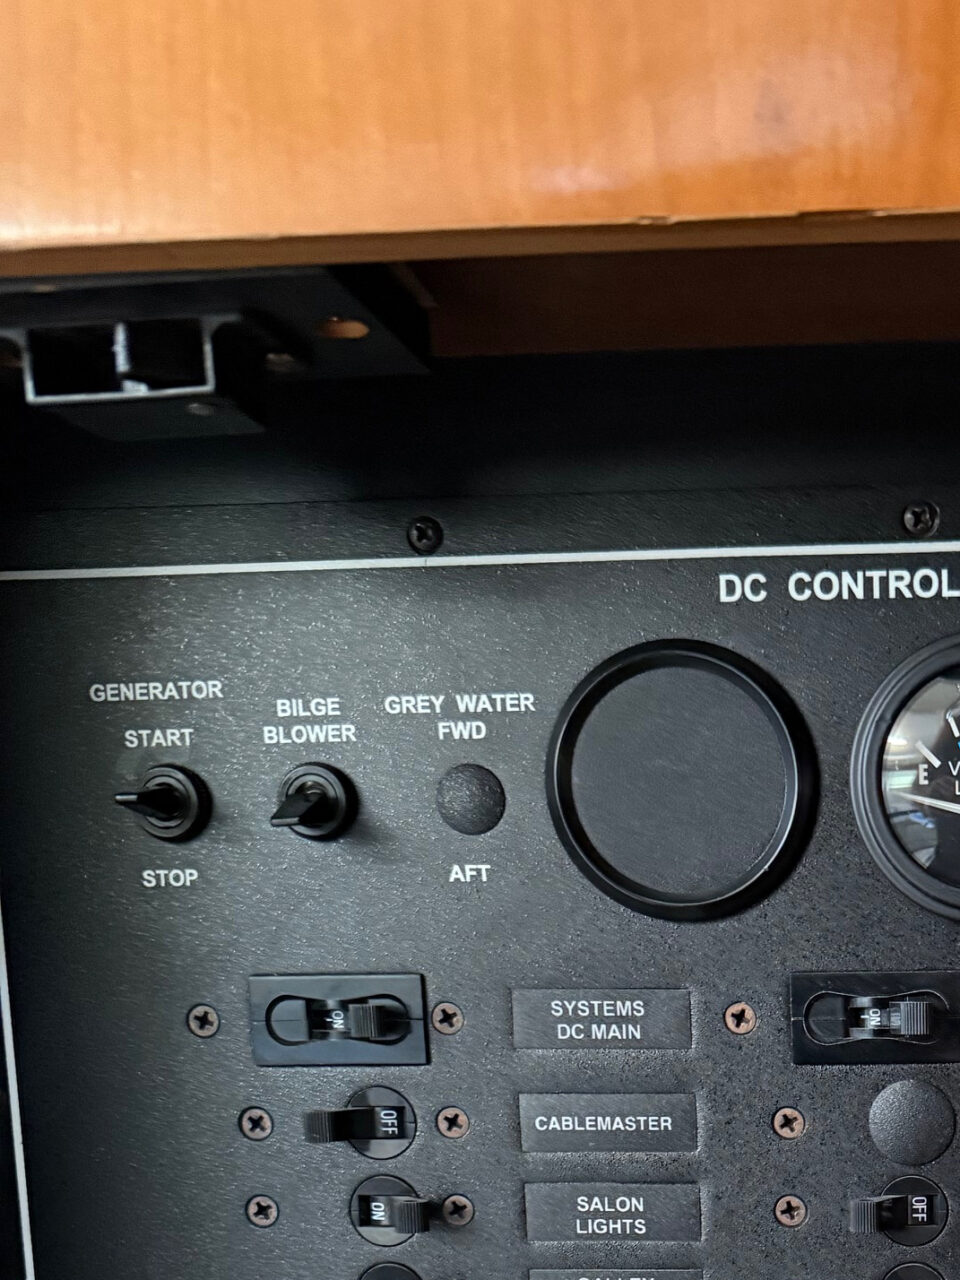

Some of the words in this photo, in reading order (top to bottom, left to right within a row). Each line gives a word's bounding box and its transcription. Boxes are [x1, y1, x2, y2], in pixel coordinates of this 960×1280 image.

[718, 574, 767, 602] DC
[788, 569, 960, 601] CONTROL
[89, 680, 223, 702] GENERATOR
[276, 698, 341, 718] BILGE
[384, 694, 444, 715] GREY
[456, 693, 536, 713] WATER
[124, 728, 194, 748] START
[262, 724, 356, 745] BLOWER
[438, 721, 487, 740] FWD
[919, 764, 928, 785] E
[141, 869, 199, 888] STOP
[449, 864, 491, 882] AFT
[550, 1001, 645, 1017] SYSTEMS
[557, 1024, 585, 1040] DC
[591, 1024, 642, 1040] MAIN
[381, 1109, 398, 1136] OFF
[534, 1116, 673, 1131] CABLEMASTER
[371, 1202, 385, 1221] ON
[576, 1197, 644, 1212] SALON
[912, 1196, 927, 1222] OFF
[576, 1219, 646, 1235] LIGHTS
